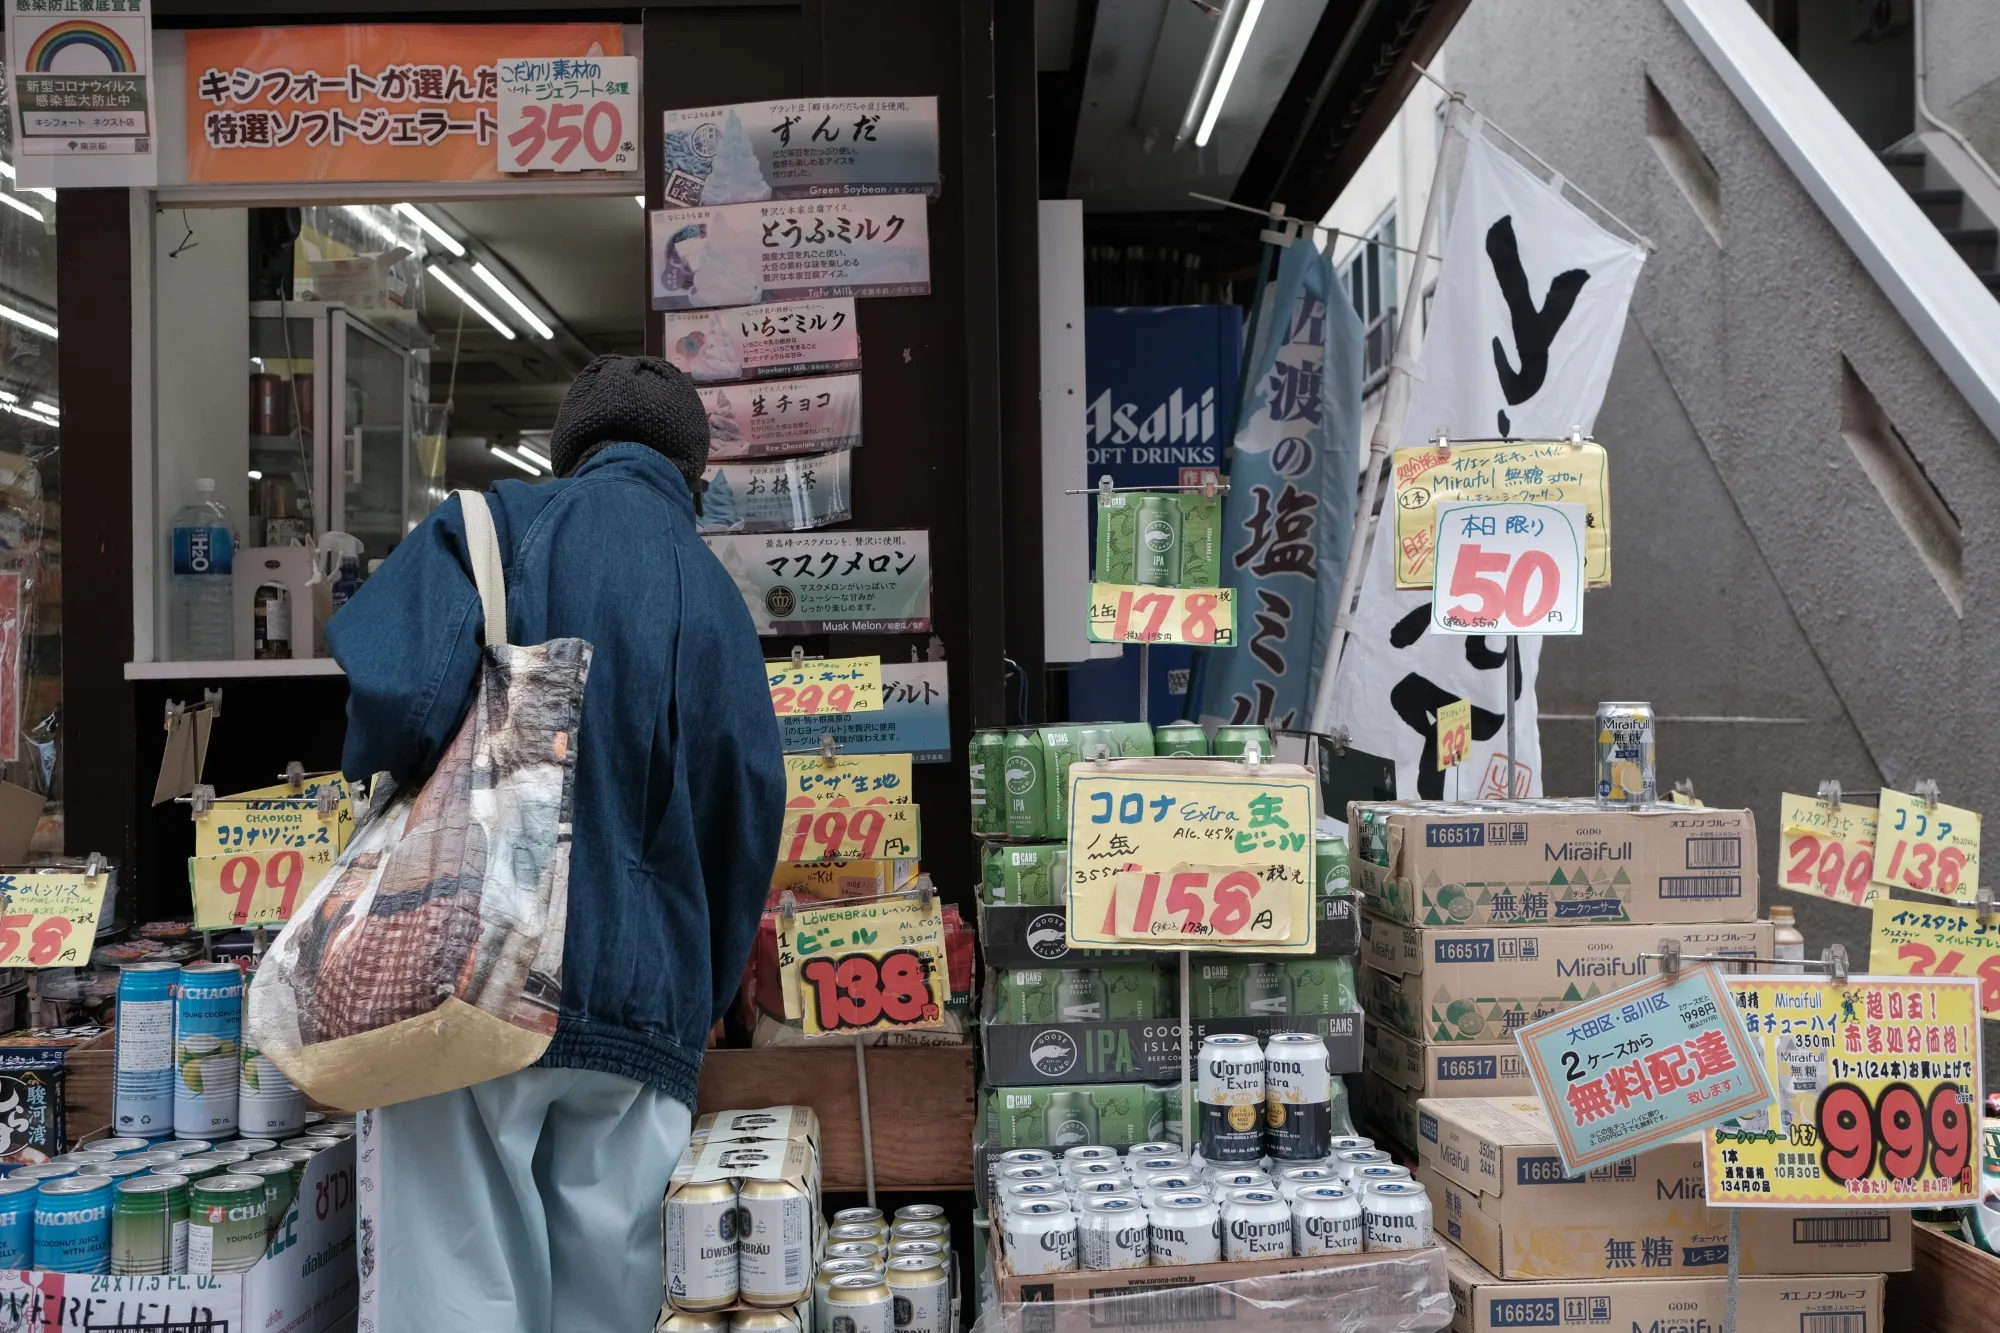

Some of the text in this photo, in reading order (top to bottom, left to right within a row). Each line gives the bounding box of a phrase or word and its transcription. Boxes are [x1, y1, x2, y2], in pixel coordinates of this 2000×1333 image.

[501, 59, 600, 82] こだわり素材の
[26, 80, 137, 92] 新型コロナウイルス
[36, 94, 130, 107] 感染拡大防止中
[35, 118, 135, 127] キシフォート ネクスト店
[206, 113, 498, 146] 特選ソフトジェラート
[771, 115, 881, 147] ずんだ
[508, 101, 622, 167] 350
[616, 154, 626, 163] 円
[809, 184, 887, 196] Green Soybean
[762, 215, 905, 248] とうふミルク
[808, 285, 853, 298] Tofu Milk
[741, 311, 846, 338] いちごミルク
[757, 363, 807, 375] Strawberry Milk
[751, 392, 831, 417] 生チョコ
[782, 441, 815, 450] Chocolate
[1132, 447, 1215, 464] DRINKS
[1505, 467, 1544, 487] 無糖
[766, 551, 916, 579] マスクメロン
[1153, 555, 1164, 566] IPA
[800, 582, 896, 591] マスクメロンがいっぱいで
[1447, 543, 1561, 628] 50
[800, 592, 875, 602] ジューシーな甘みが
[801, 603, 876, 613] しっかり楽しめます。
[1090, 603, 1116, 618] 1缶
[823, 620, 882, 631] Musk Melon
[1113, 591, 1218, 643] 178
[1549, 611, 1563, 623] 円
[1214, 628, 1232, 645] 円
[771, 684, 855, 713] 299
[854, 700, 868, 709] 円
[1603, 718, 1650, 730] Miraifull
[1613, 733, 1640, 745] 無糖
[800, 773, 901, 793] ピザ生地
[969, 763, 986, 805] IPA
[1013, 799, 1025, 812] IPA
[1091, 792, 1177, 824] コロナ
[1181, 801, 1240, 822] Extra
[246, 814, 302, 823] CHAOKOH
[1895, 809, 1952, 840] ココア
[217, 826, 329, 847] ココナツジュース
[788, 809, 886, 862] 199
[1234, 831, 1306, 853] ビール
[1431, 827, 1480, 844] 166517
[884, 837, 905, 857] 円
[1545, 841, 1632, 861] Miraifull
[1020, 852, 1037, 863] CANS
[1787, 835, 1873, 905] 299
[1886, 839, 1967, 895] 138
[220, 850, 304, 925] 99
[1572, 890, 1604, 899] チューハイ
[1133, 871, 1261, 935] 158
[1326, 902, 1349, 916] CANS
[1491, 892, 1549, 920] 無糖
[803, 909, 876, 926] LÖWENBRÄU
[1251, 909, 1274, 931] 円
[1892, 911, 1968, 932] インスタント
[797, 928, 878, 955] ビール
[58, 948, 77, 961] 円
[1439, 942, 1489, 959] 166517
[1557, 957, 1646, 978] Miraifull
[1025, 972, 1042, 982] CANS
[803, 950, 931, 1030] 138
[1775, 992, 1823, 1010] Miraifull
[921, 1004, 939, 1021] 円
[1567, 992, 1671, 1045] 大田区・品川区
[1680, 1003, 1717, 1023] 1998円
[1330, 1018, 1353, 1033] CANS
[1039, 1034, 1068, 1045] GOOSE
[1795, 1034, 1836, 1048] 350ml
[1085, 1028, 1134, 1074] IPA
[1147, 1055, 1166, 1063] BEER
[1781, 1051, 1825, 1063] Miraifull
[1442, 1060, 1492, 1077] 166517
[1791, 1066, 1817, 1078] 無糖
[1226, 1077, 1258, 1090] Extra
[1566, 1029, 1737, 1127] 無料配達
[1015, 1095, 1032, 1106] CANS
[27, 1086, 47, 1146] 駿河湾
[1420, 1112, 1437, 1144] 166525
[1790, 1125, 1817, 1146] レモン
[1820, 1087, 1970, 1181] 999
[1440, 1144, 1469, 1175] Miraifull
[1479, 1141, 1496, 1161] 350ml
[1722, 1150, 1738, 1164] 1本
[1725, 1167, 1765, 1180] 通常価格
[1775, 1167, 1820, 1179] 10月30日
[1960, 1166, 1972, 1193] 円
[1721, 1181, 1771, 1193] 134円の品
[1846, 1178, 1917, 1194] 1本あたり なんと
[1445, 1187, 1462, 1218] 無糖
[226, 1233, 253, 1243] YOUNG
[1231, 1218, 1290, 1241] Corona
[1368, 1227, 1402, 1243] Extra
[75, 1234, 100, 1245] JUICE
[1250, 1239, 1284, 1253] Extra
[1324, 1235, 1358, 1249] Extra
[62, 1246, 86, 1256] WITH
[1605, 1237, 1673, 1268] 無糖
[1690, 1248, 1728, 1263] レモン
[1128, 1275, 1196, 1287] www.corona-extra.jp
[1495, 1304, 1554, 1322] 166525
[1668, 1303, 1698, 1311] GODO
